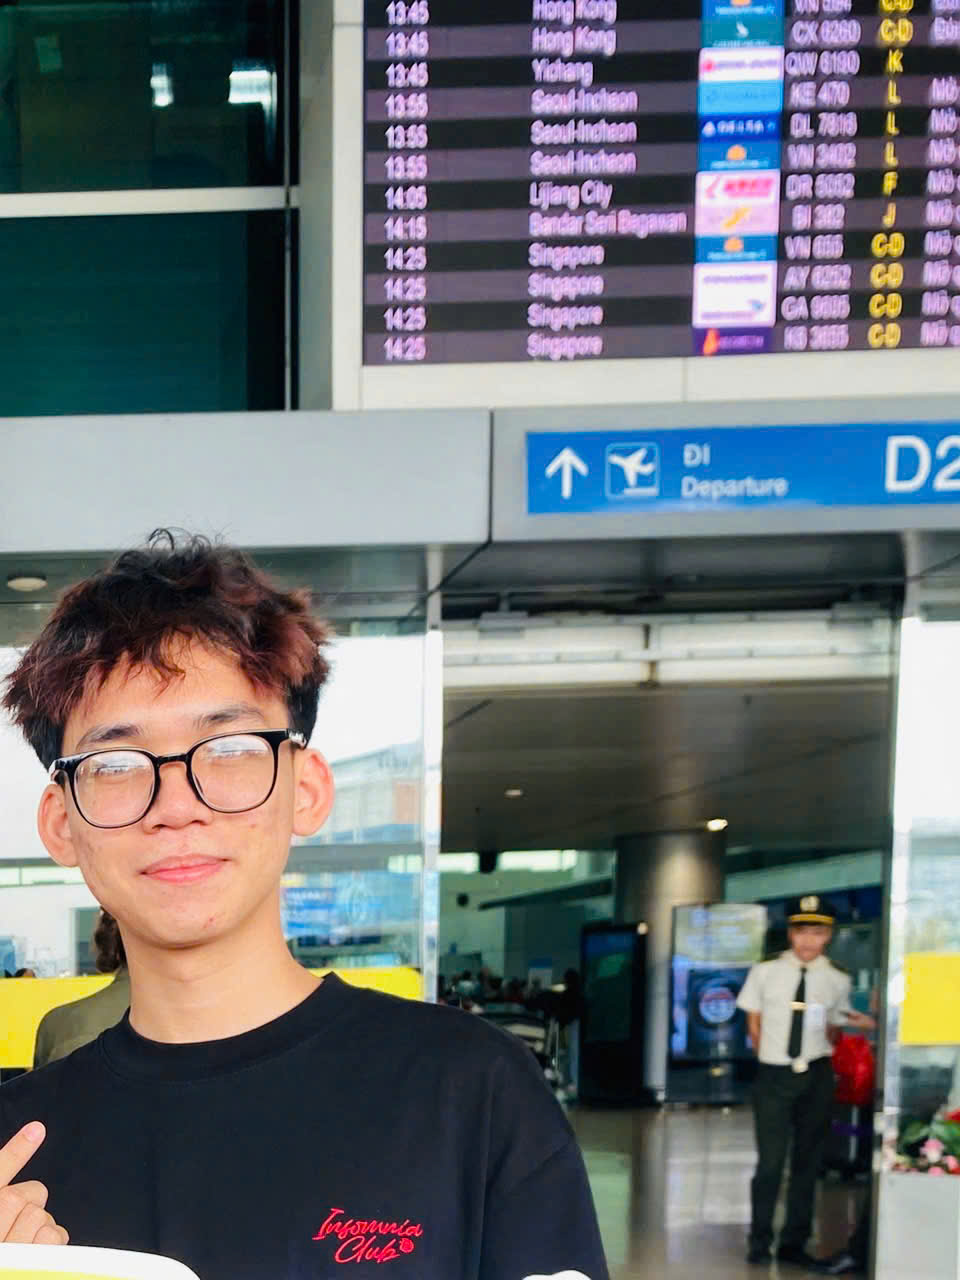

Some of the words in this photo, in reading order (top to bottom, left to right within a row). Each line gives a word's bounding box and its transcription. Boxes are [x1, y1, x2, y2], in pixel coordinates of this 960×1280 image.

[387, 0, 429, 25] 13:45
[387, 31, 429, 57] 13:45
[533, 27, 573, 57] Hong
[575, 26, 617, 56] Kong
[386, 62, 429, 87] 13:45
[887, 50, 903, 73] K
[386, 93, 429, 119] 13:55
[888, 80, 901, 104] L
[385, 124, 428, 149] 13:55
[887, 111, 899, 135] L
[385, 155, 428, 180] 13:55
[886, 142, 898, 166] L
[581, 181, 613, 209] City
[529, 243, 605, 271] Singapore
[528, 272, 604, 301] Singapore
[528, 303, 603, 332] Singapore
[527, 332, 603, 361] Singapore
[681, 475, 788, 500] Departure
[312, 1208, 424, 1240] Insomnia
[335, 1235, 400, 1263] Club
